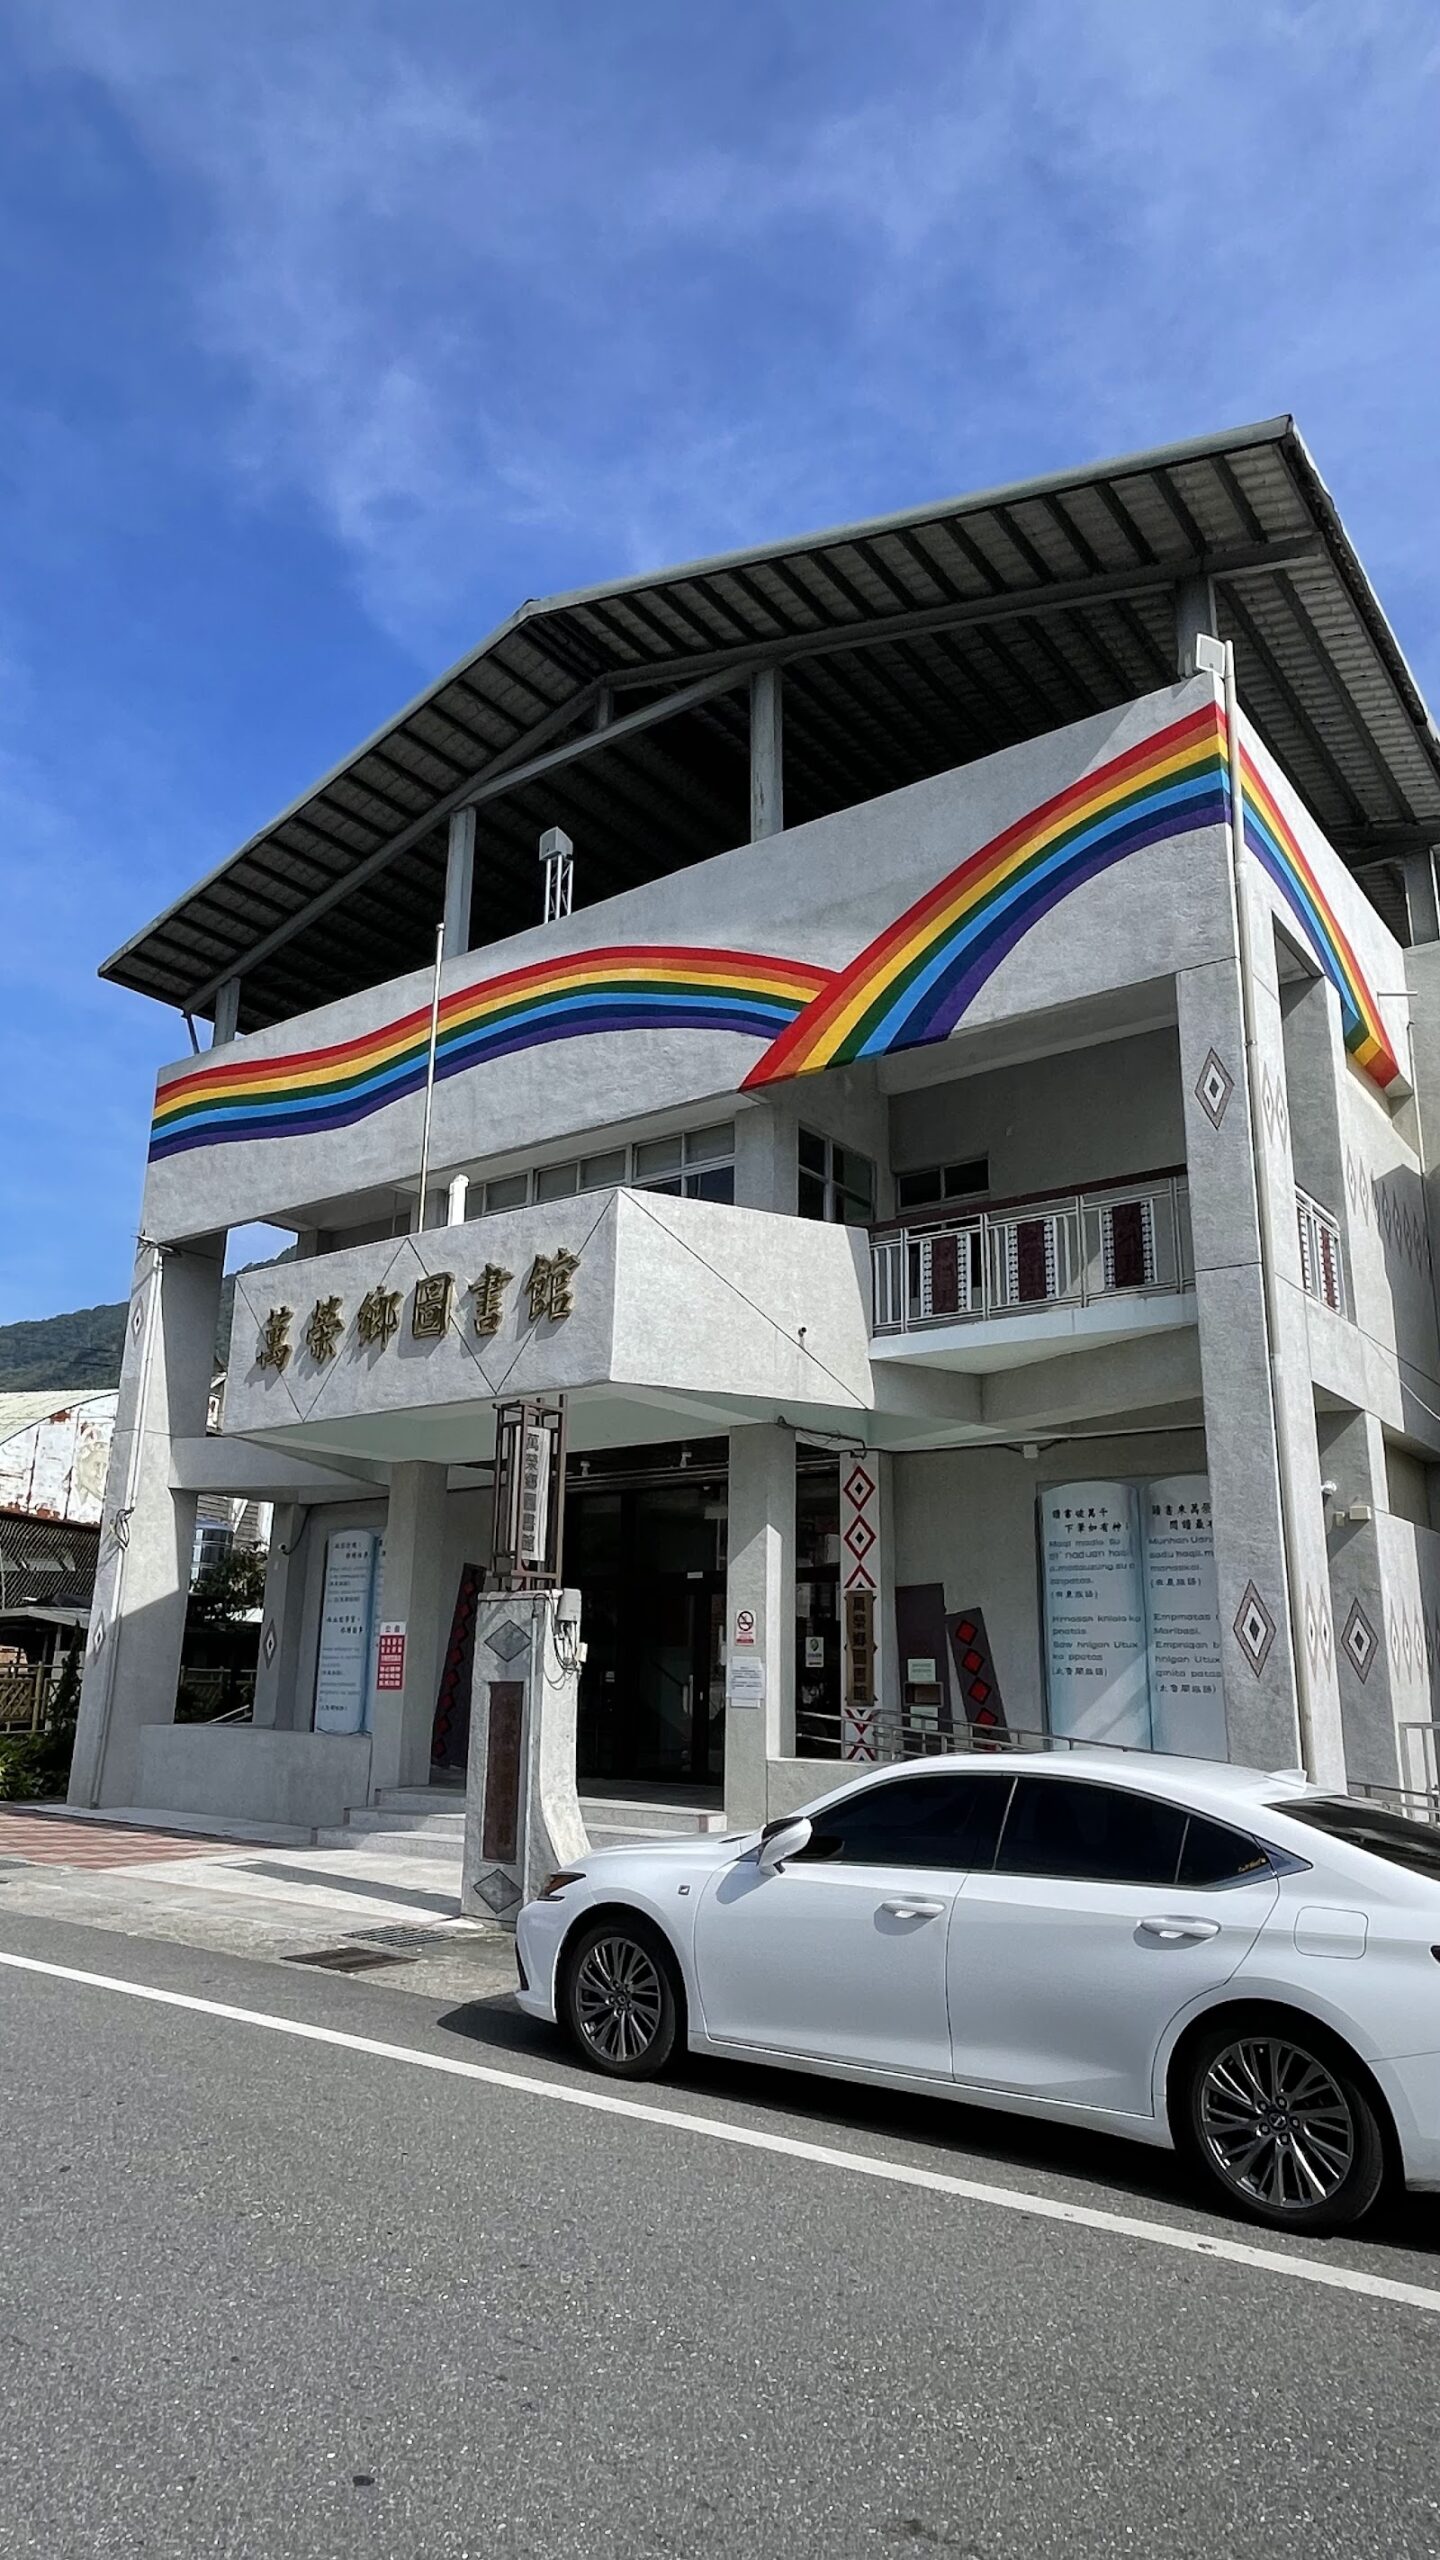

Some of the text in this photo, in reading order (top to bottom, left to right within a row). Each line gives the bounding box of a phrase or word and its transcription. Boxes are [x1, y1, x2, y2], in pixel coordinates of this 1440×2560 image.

[255, 1247, 582, 1375] 萬榮鄉圖書館
